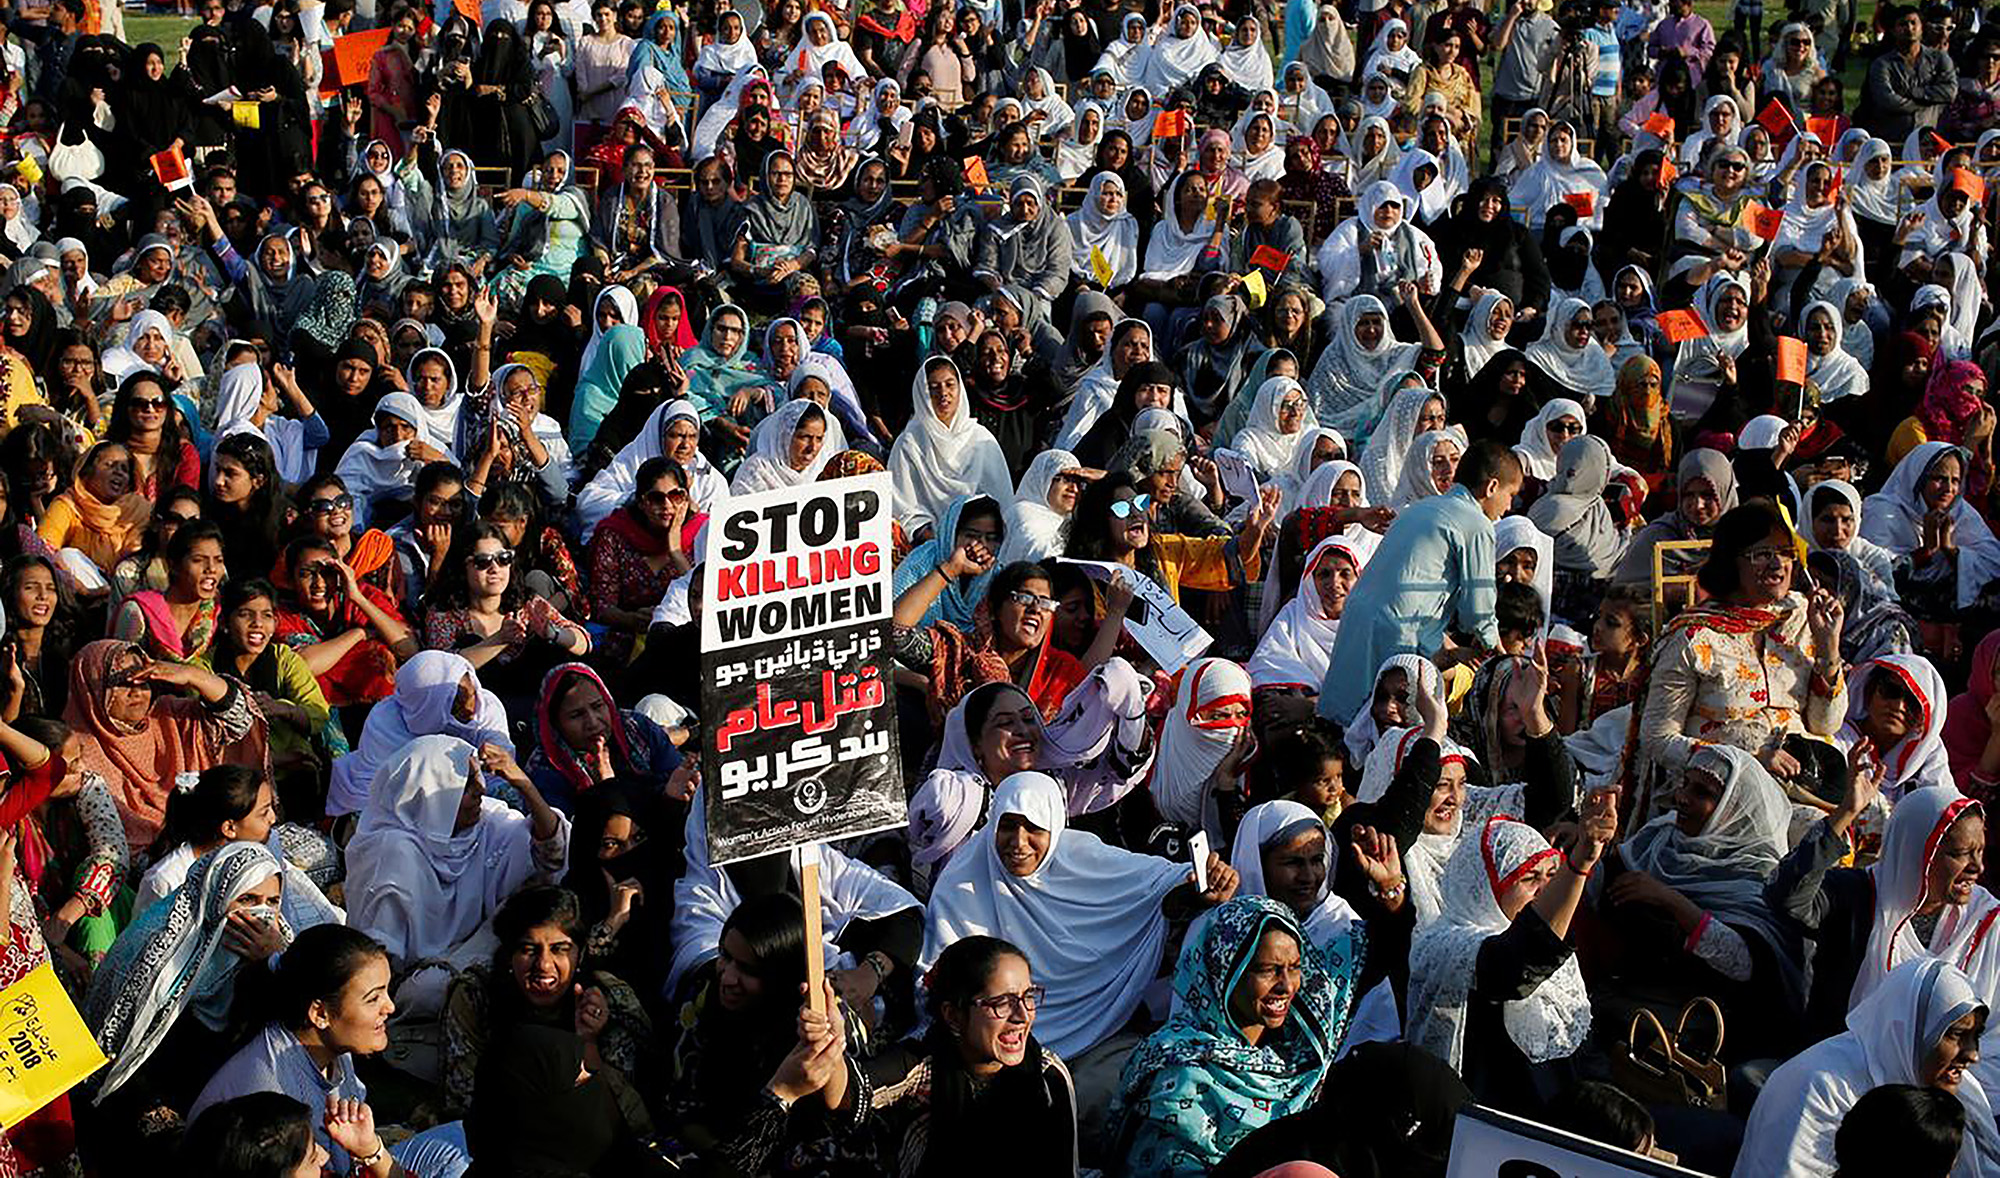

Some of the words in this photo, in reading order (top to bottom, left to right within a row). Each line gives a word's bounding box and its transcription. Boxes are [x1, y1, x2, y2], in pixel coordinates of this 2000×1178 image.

[722, 490, 880, 561] STOP
[717, 542, 880, 601] KILLING
[717, 582, 882, 642] WOMEN
[716, 682, 800, 753] عام
[802, 666, 885, 735] قتل
[838, 720, 889, 764] بند
[760, 825, 790, 839] Action
[791, 818, 820, 831] Forum
[8, 1031, 42, 1069] 2018
